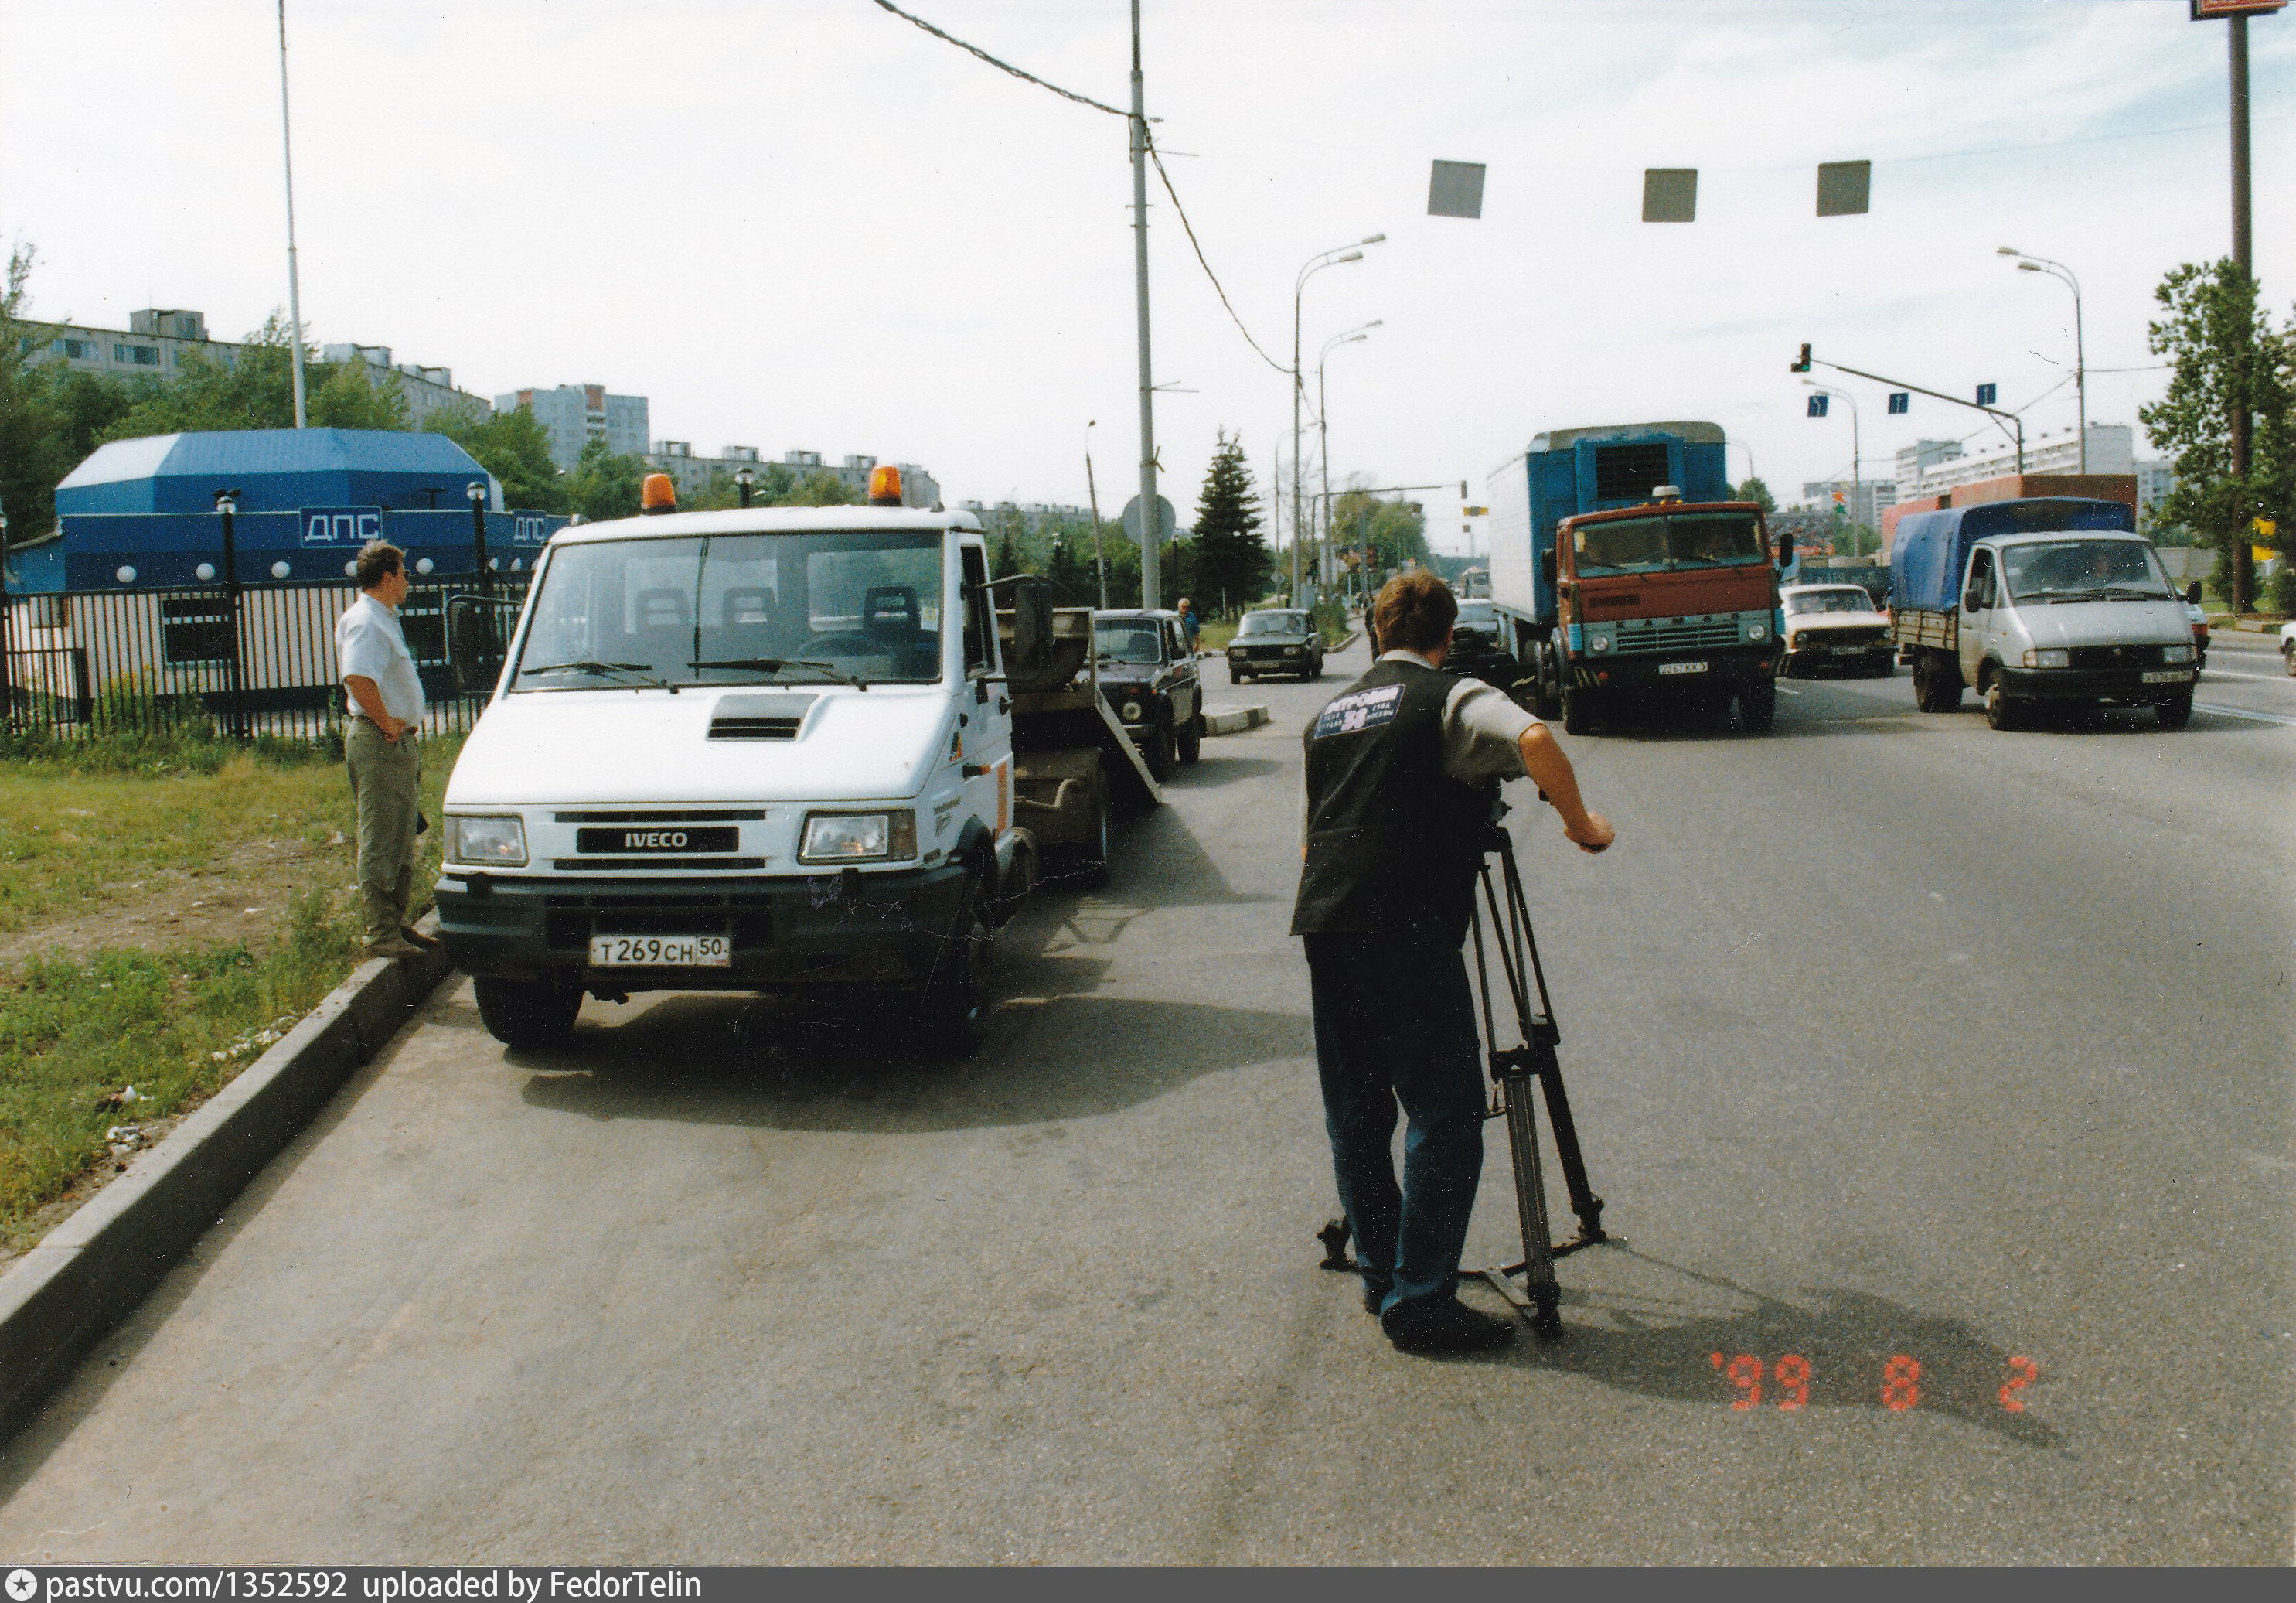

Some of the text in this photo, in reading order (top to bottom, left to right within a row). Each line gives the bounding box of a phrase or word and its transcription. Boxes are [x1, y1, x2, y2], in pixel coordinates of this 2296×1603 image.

[305, 513, 379, 541] ДПС
[513, 517, 544, 541] ДПС
[625, 830, 688, 848] IVECO
[699, 938, 723, 955] 50
